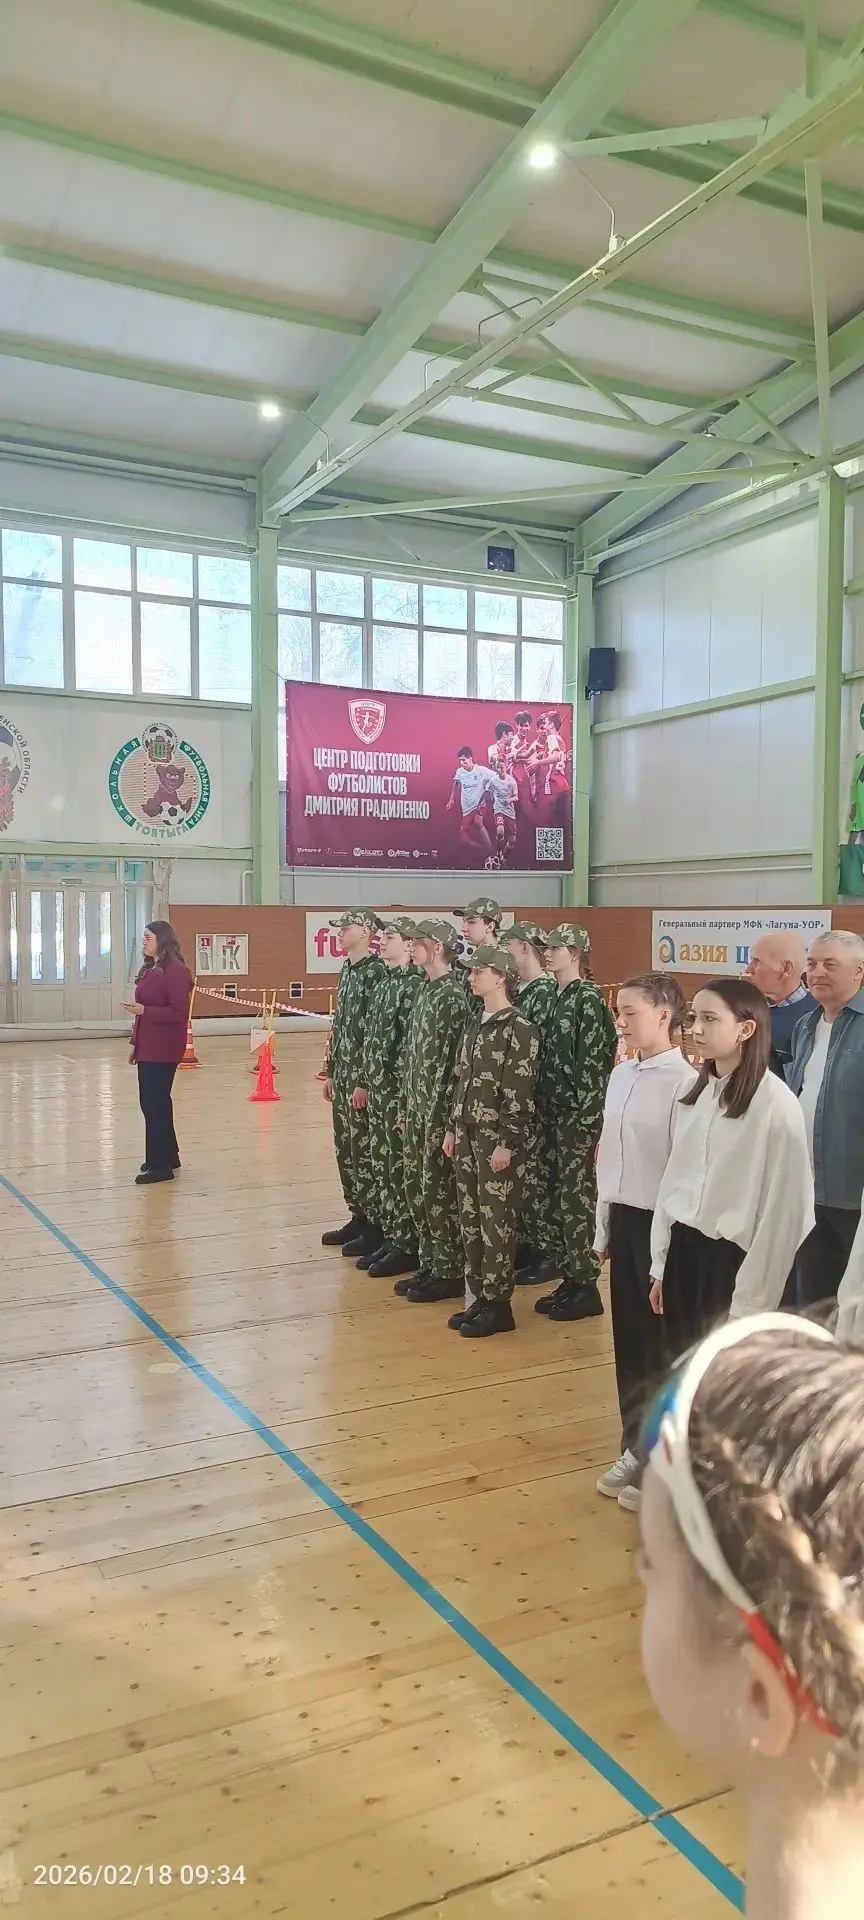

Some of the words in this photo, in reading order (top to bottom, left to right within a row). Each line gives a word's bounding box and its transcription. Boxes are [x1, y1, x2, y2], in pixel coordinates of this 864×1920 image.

[17, 750, 31, 794] ОБЛАСТИ
[313, 747, 349, 770] ЦЕНТР
[350, 750, 421, 773] ПОДГОТОВКИ
[110, 741, 138, 823] ШКОЛЬНАЯ
[183, 744, 209, 802] ФУТБОЛЬНАЯ
[327, 772, 408, 796] ФУТБОЛИСТОВ
[189, 804, 205, 825] ЛИГА
[304, 795, 359, 817] ДМИТРИЯ
[361, 798, 430, 820] ГРАДИЛЕНКО
[136, 821, 189, 838] ТОПТЫГА
[659, 919, 707, 929] Генеральный
[709, 921, 741, 930] партнер
[743, 920, 762, 929] МФК
[765, 920, 824, 931] «Лагуна-УОР»
[679, 943, 728, 963] азия
